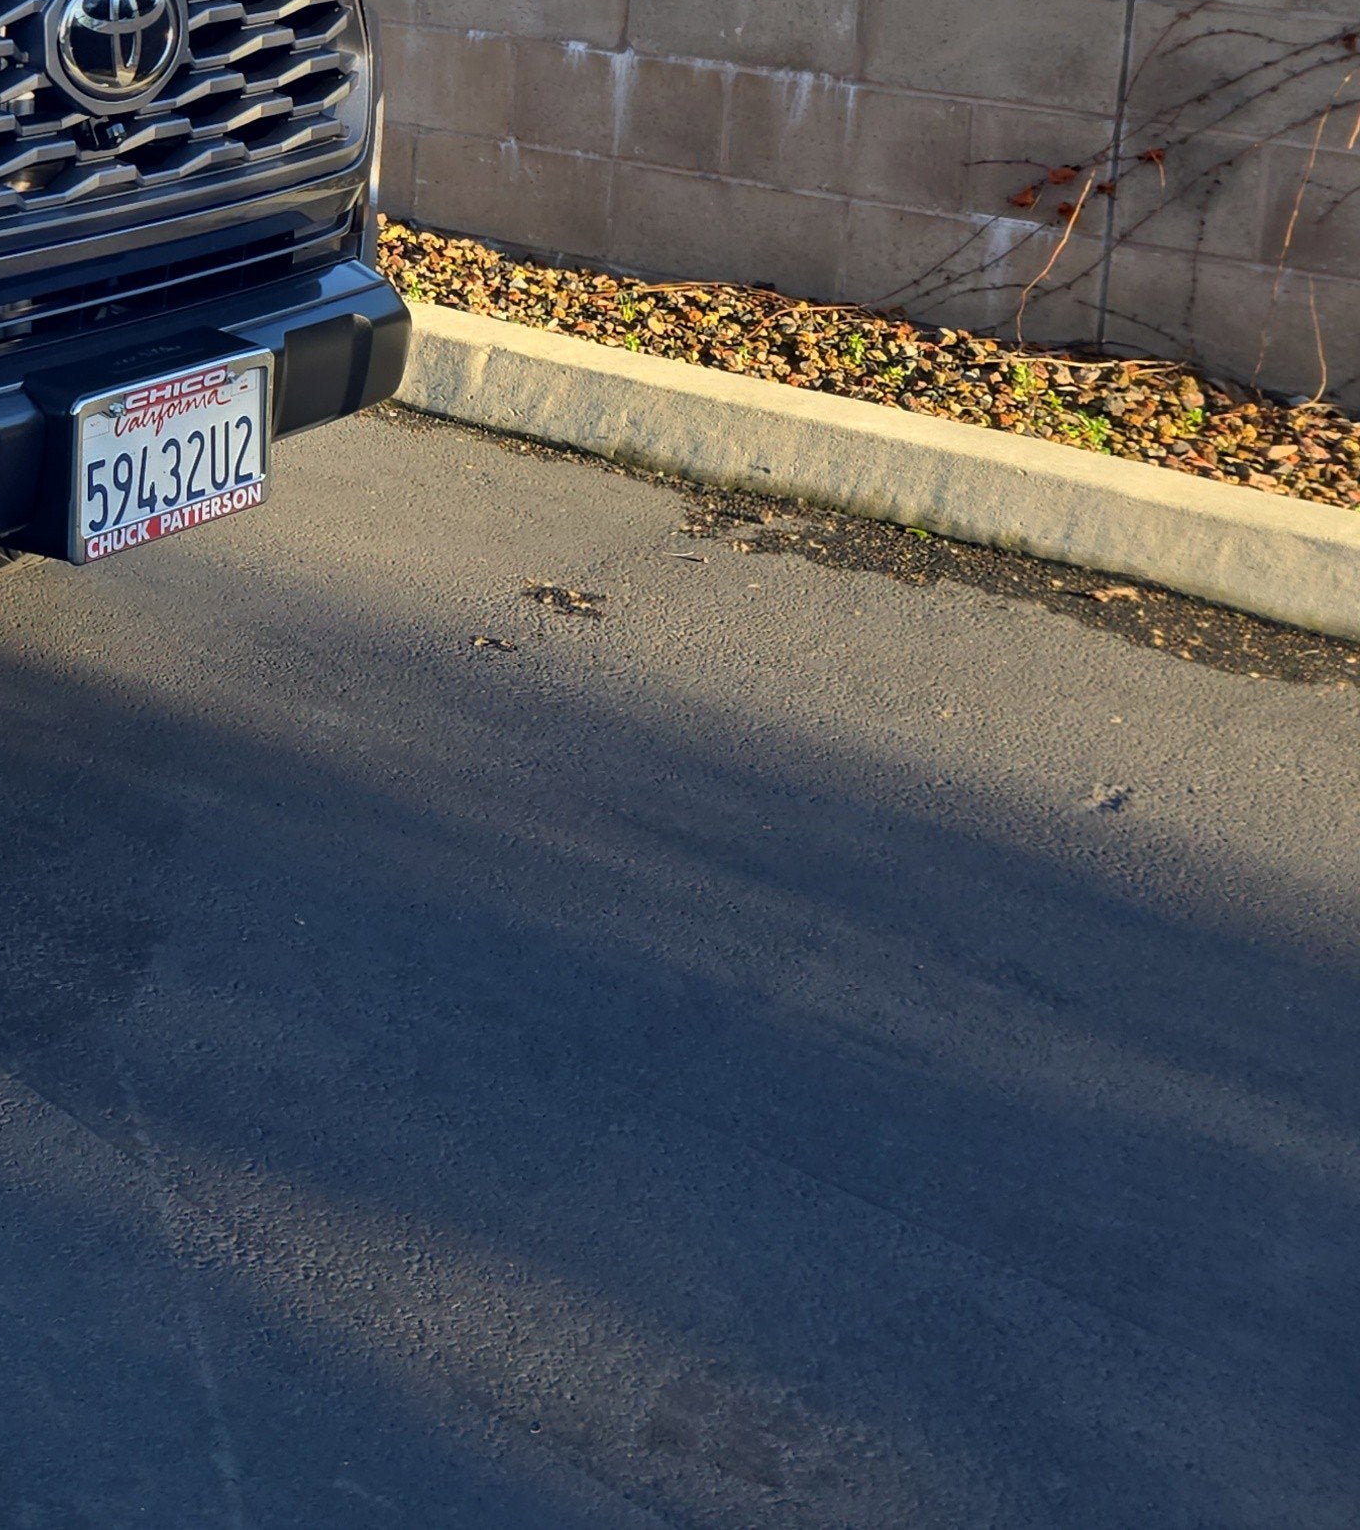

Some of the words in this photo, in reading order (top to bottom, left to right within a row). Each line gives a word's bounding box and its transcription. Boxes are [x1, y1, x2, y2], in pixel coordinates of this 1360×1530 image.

[126, 369, 227, 409] CHICO
[87, 415, 253, 532] 59432U2
[87, 520, 151, 559] CHUCK
[160, 483, 262, 535] PATTERSON
